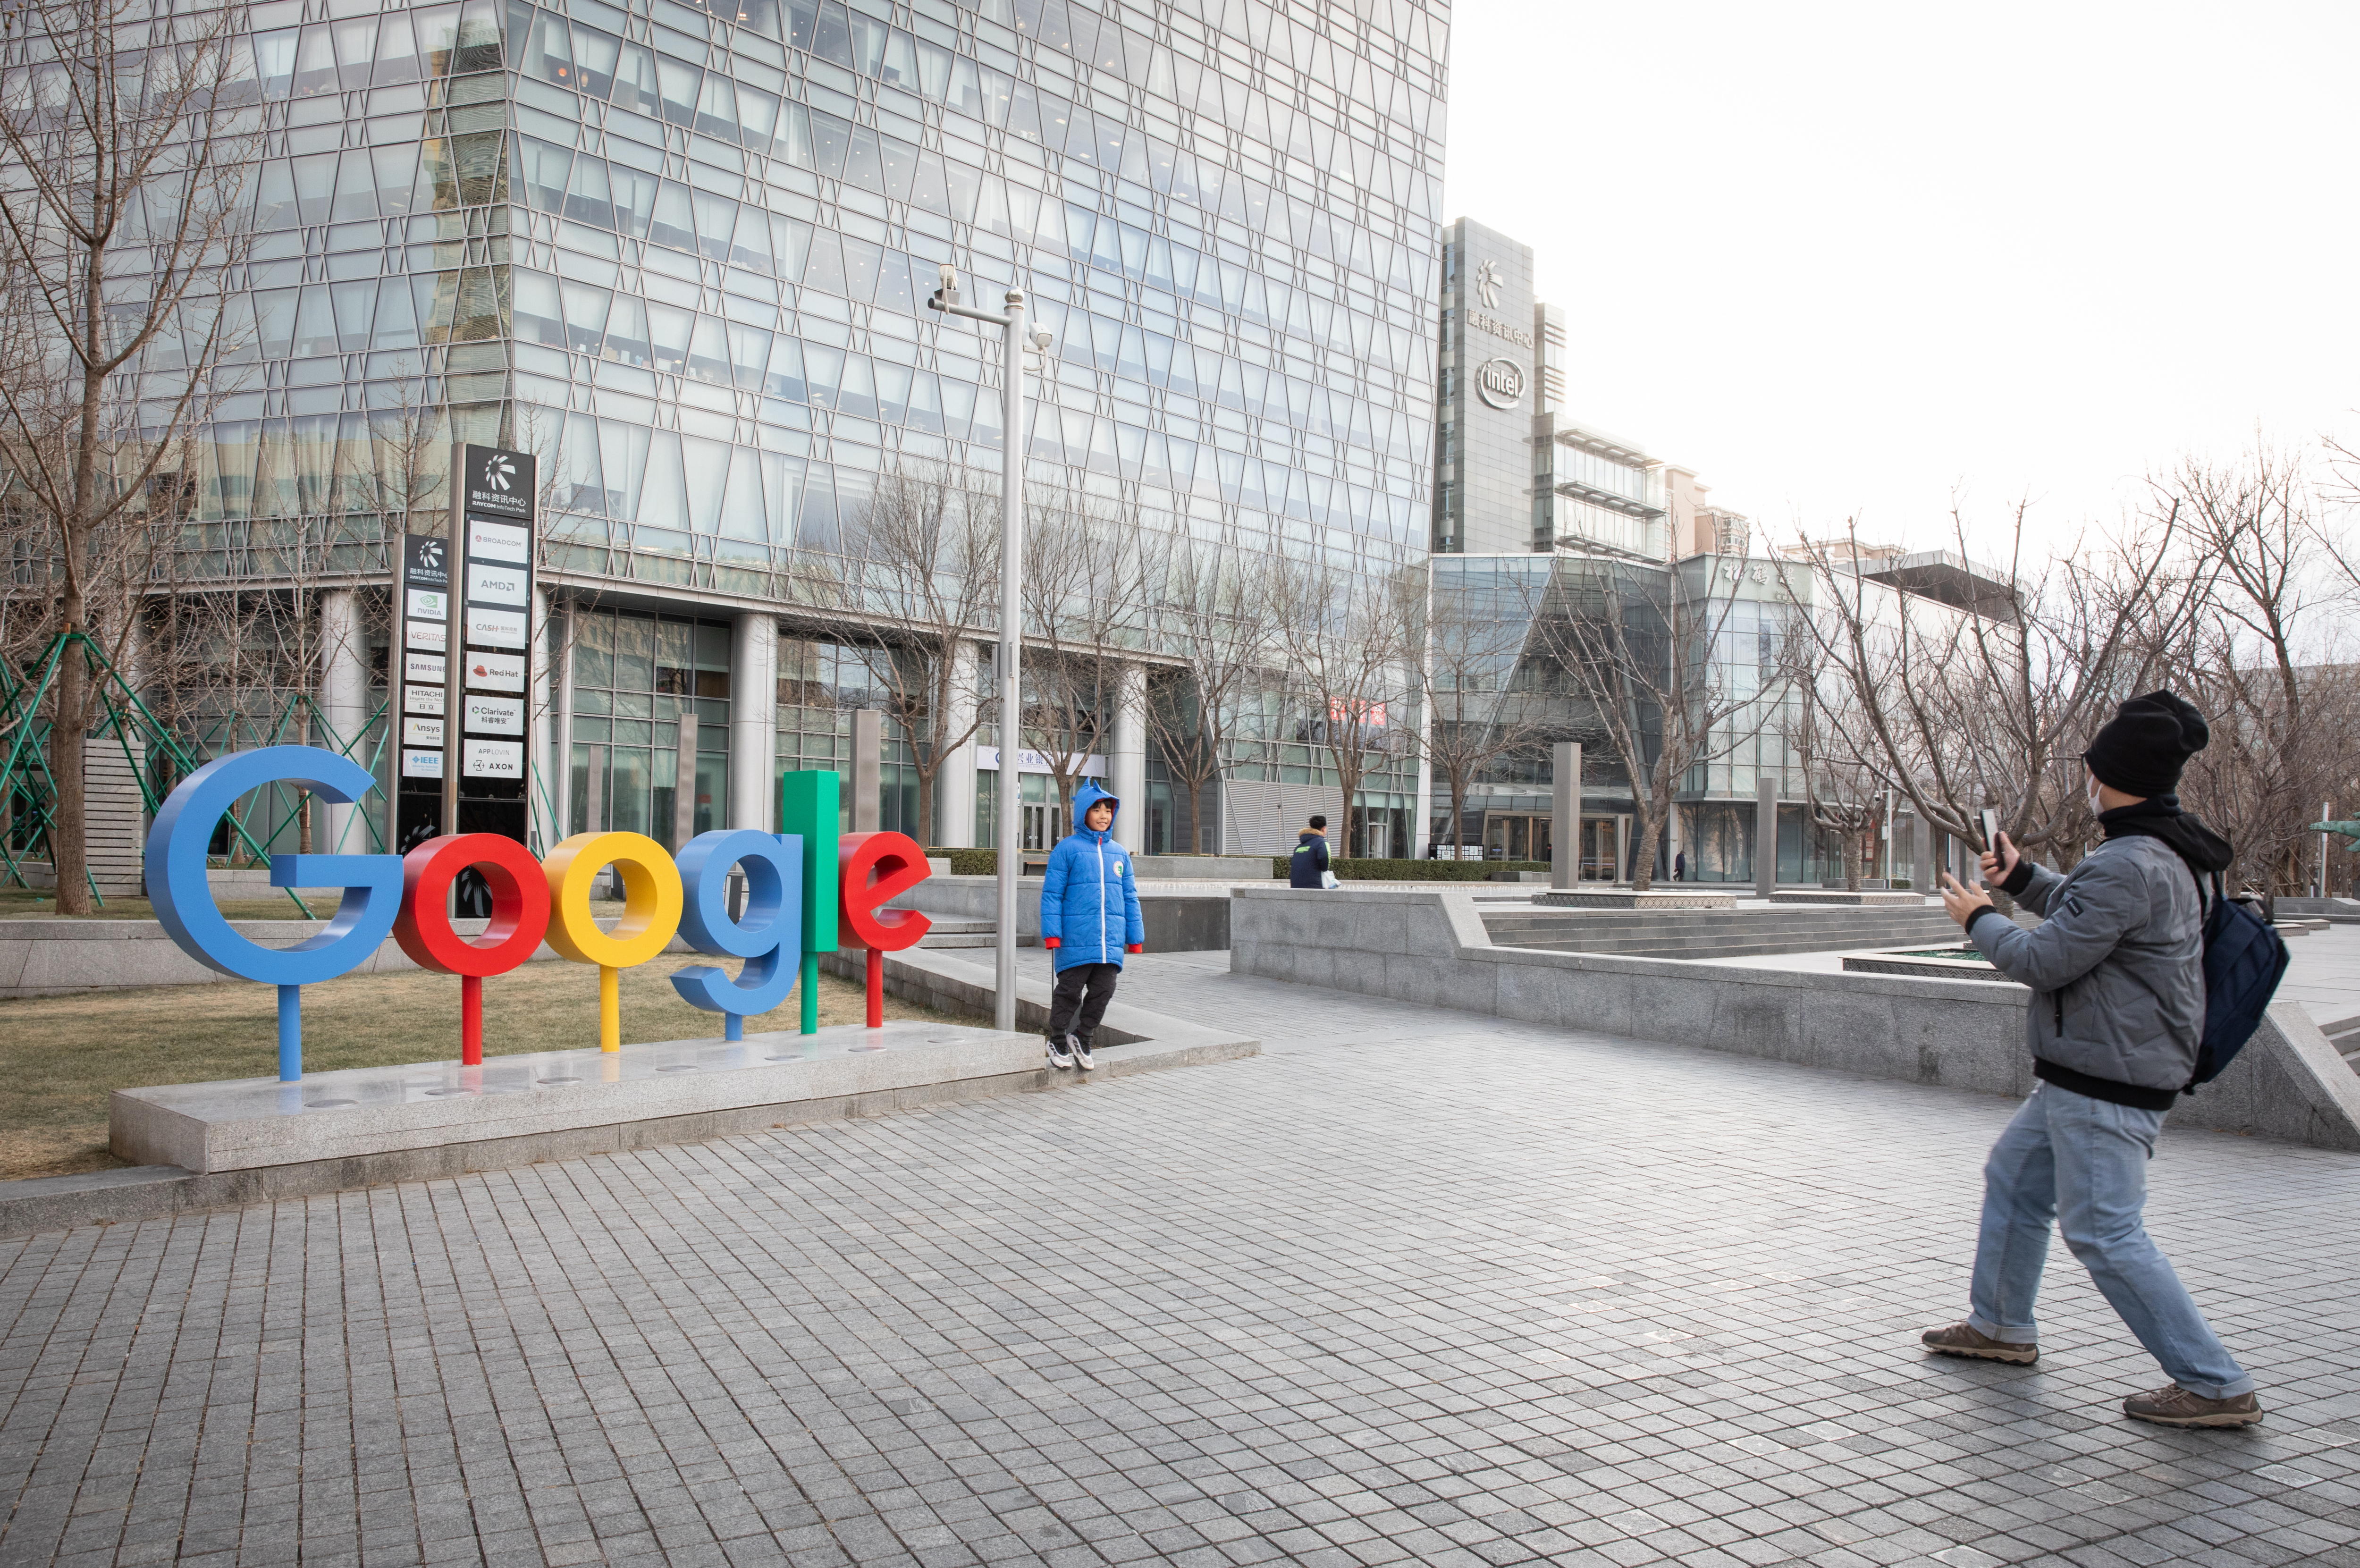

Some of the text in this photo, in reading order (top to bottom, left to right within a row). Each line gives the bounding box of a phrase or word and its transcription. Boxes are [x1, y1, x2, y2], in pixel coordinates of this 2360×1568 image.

[1467, 309, 1534, 348] 融科资讯中心
[1487, 363, 1519, 397] intel
[472, 490, 526, 506] 融科资讯中心
[483, 537, 521, 547] BROADCOM
[481, 580, 506, 590] AMD
[411, 631, 446, 642] VERITAS
[413, 723, 440, 733] Ansys
[421, 756, 438, 764] IEEE
[146, 745, 933, 1015] Google
